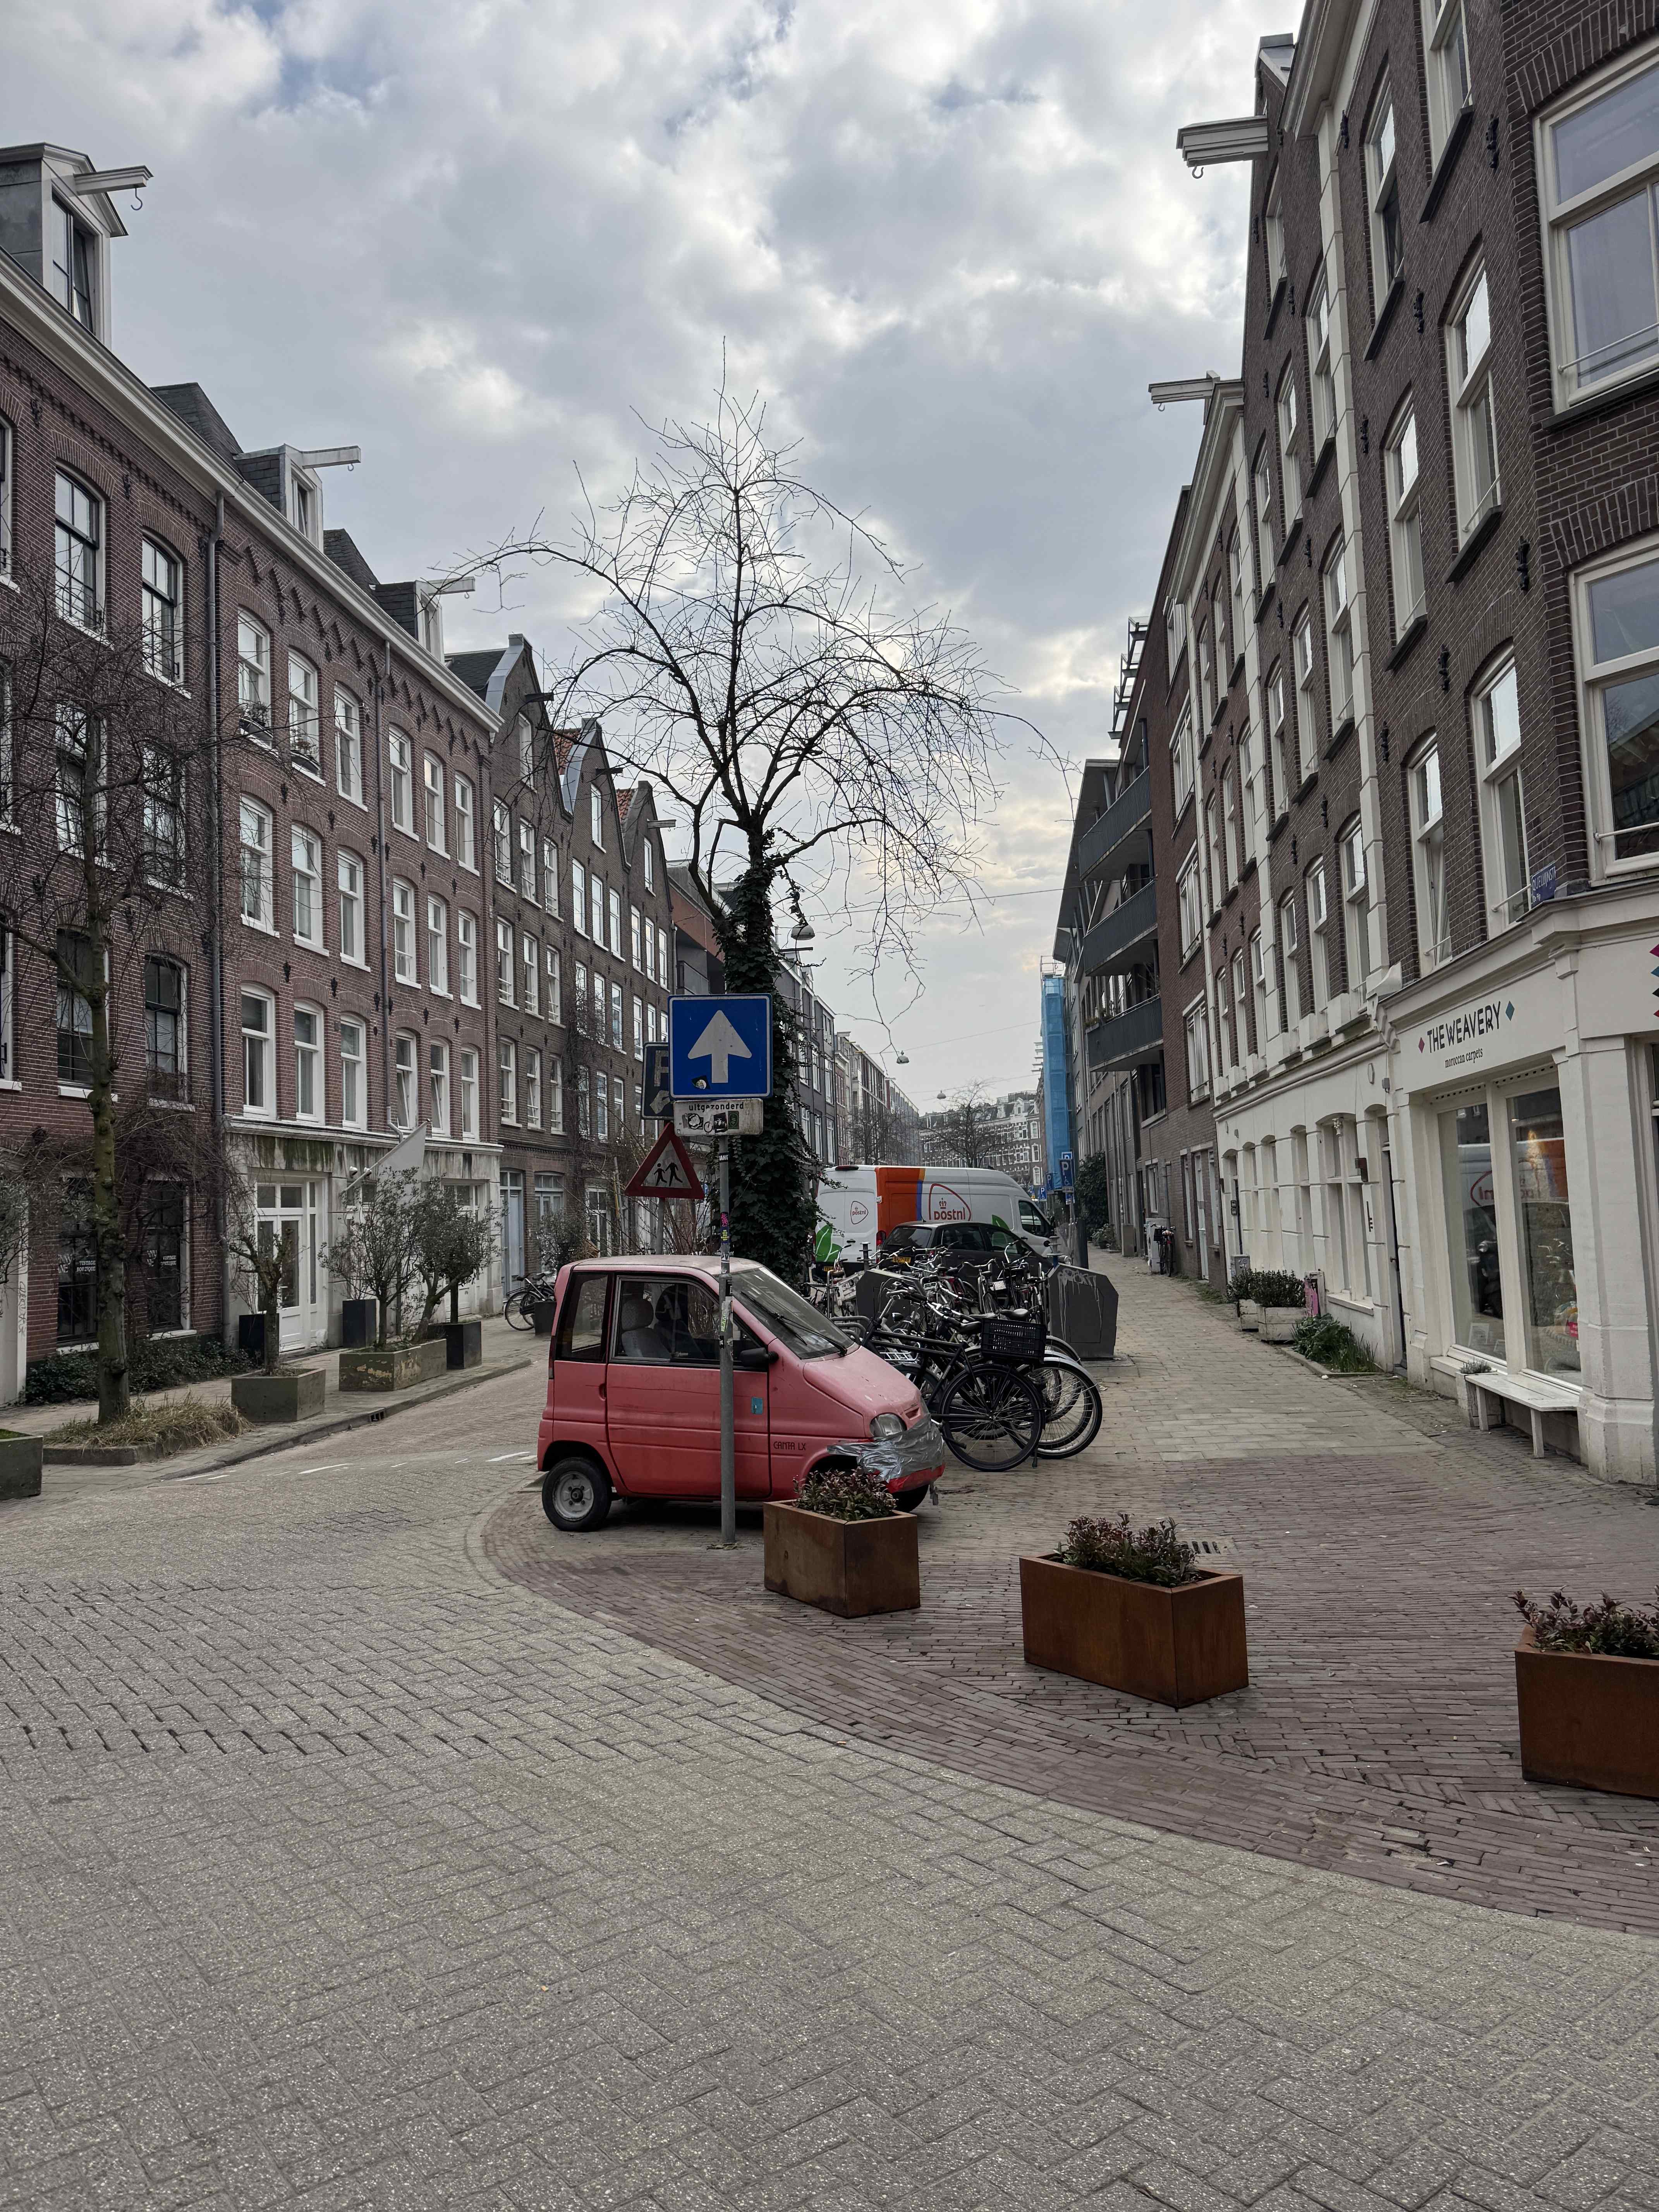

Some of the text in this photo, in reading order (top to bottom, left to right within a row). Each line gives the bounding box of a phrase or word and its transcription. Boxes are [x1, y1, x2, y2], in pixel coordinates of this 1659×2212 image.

[1427, 1001, 1501, 1053] THE WEAVERY
[1445, 1048, 1483, 1068] moroccan carpets
[689, 1102, 744, 1113] uitgezonderd
[1061, 1162, 1069, 1175] P
[934, 1207, 965, 1220] postnl
[773, 1441, 806, 1451] CANTA LX
